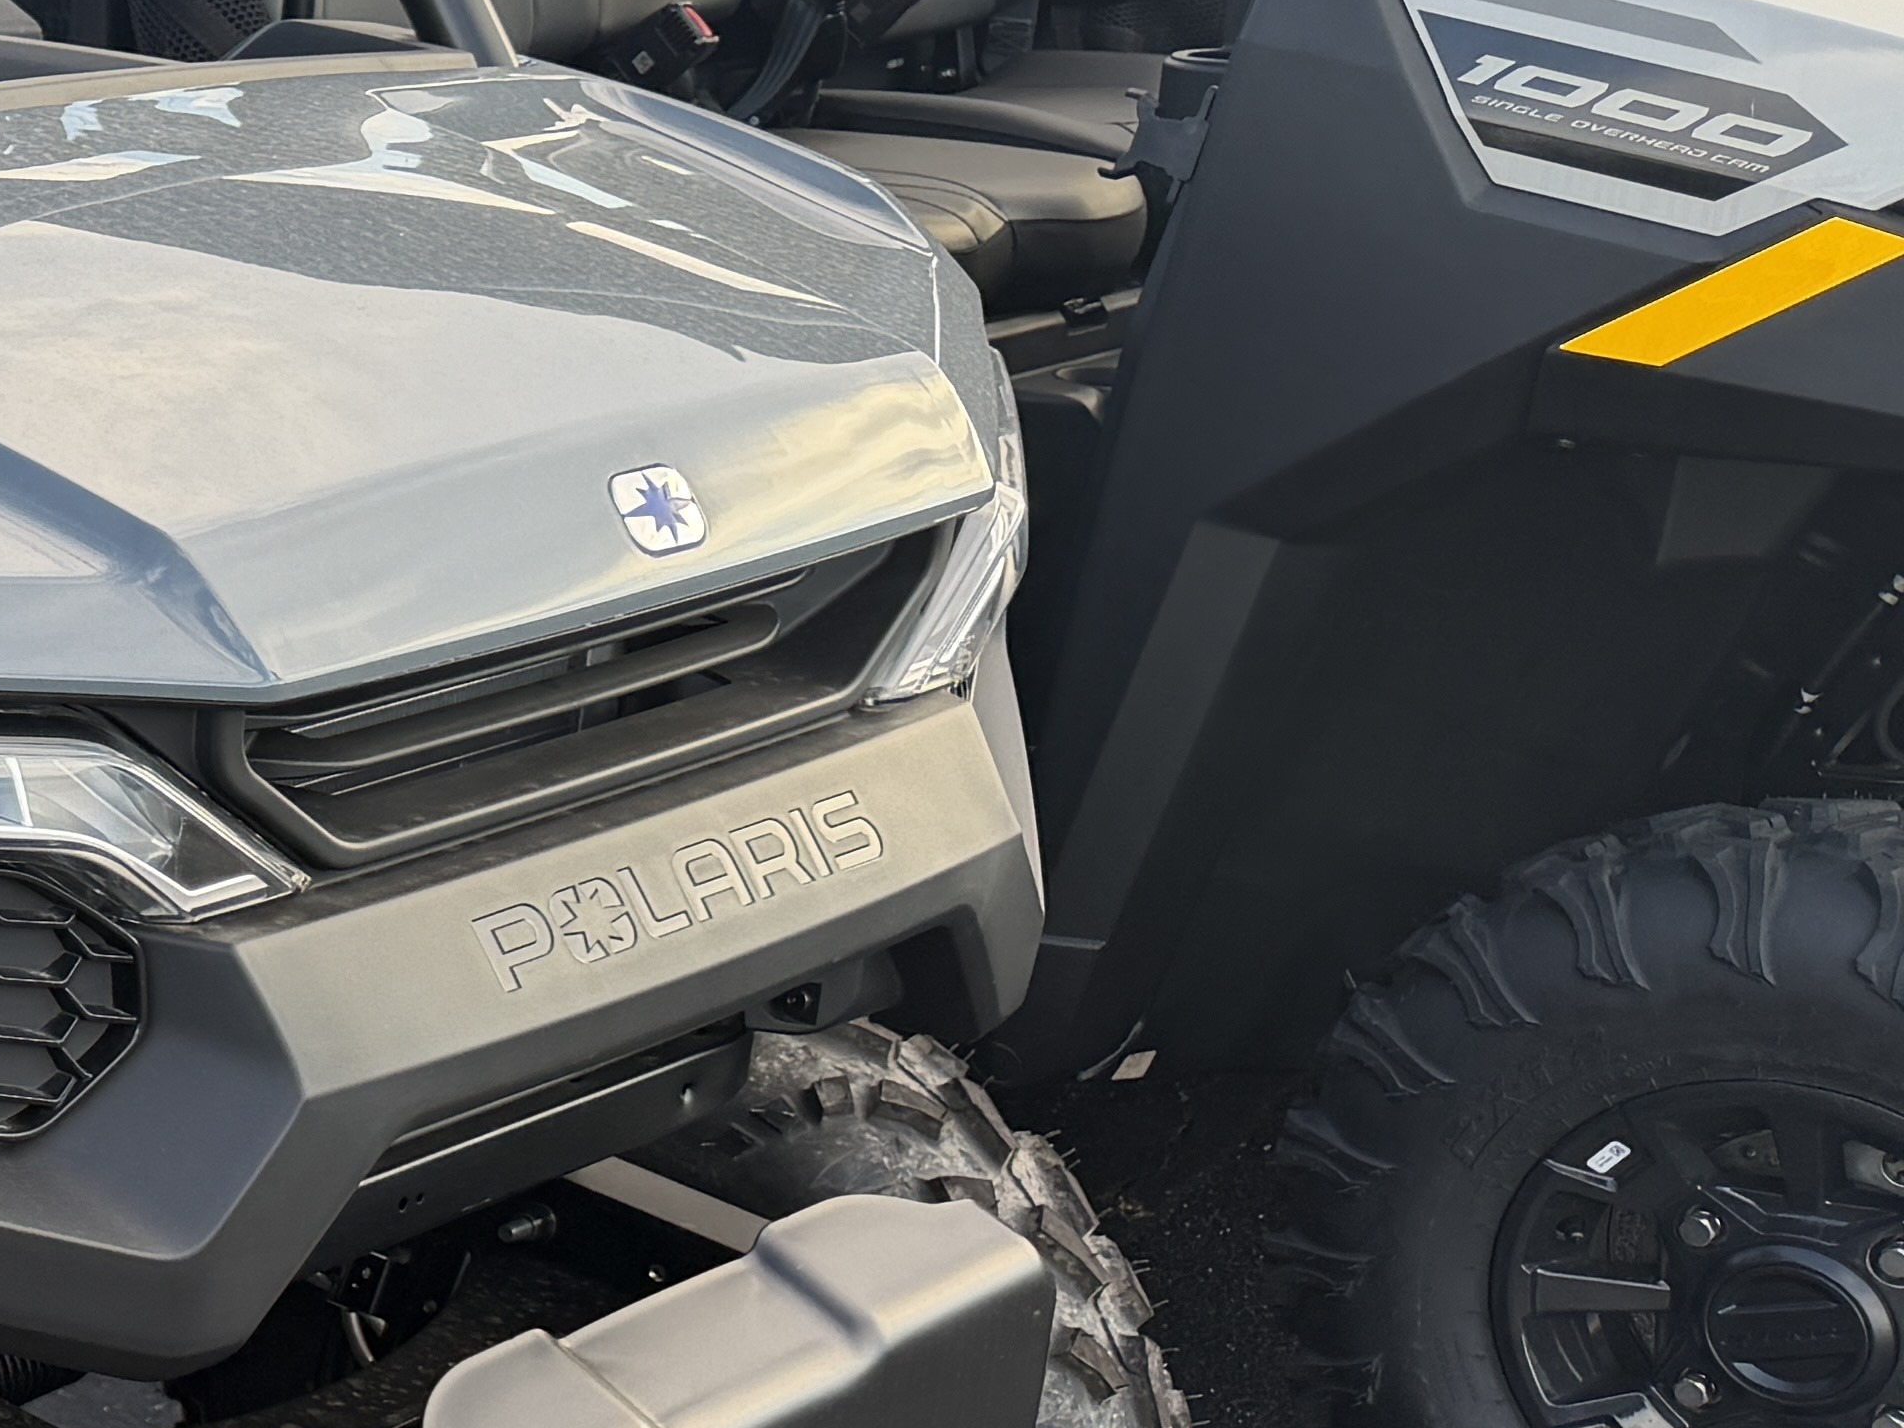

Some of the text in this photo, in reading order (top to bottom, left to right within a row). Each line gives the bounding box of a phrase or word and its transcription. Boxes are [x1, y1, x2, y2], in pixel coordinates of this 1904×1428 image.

[1457, 54, 1813, 158] 1000
[1471, 94, 1770, 174] SINGLE OVERHEAD CAM
[470, 789, 885, 993] POLARIS
